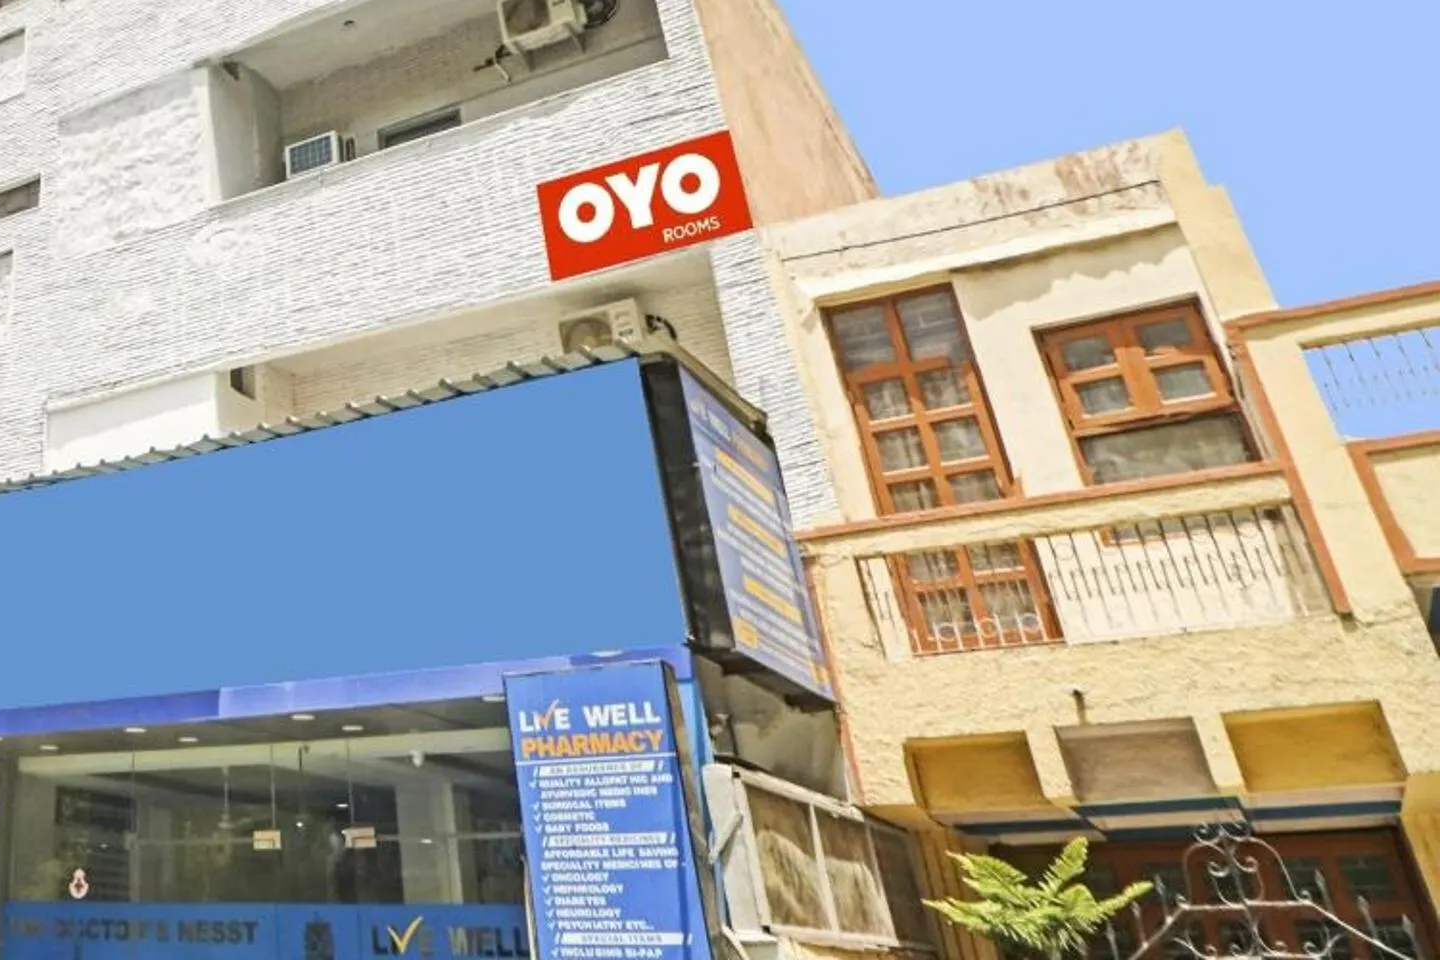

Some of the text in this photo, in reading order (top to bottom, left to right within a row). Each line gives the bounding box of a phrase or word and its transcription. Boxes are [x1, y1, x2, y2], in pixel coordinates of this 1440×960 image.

[558, 153, 720, 243] OYO
[662, 216, 721, 243] ROOMS
[582, 701, 661, 728] WELL
[521, 728, 663, 759] PHARMACY
[550, 872, 609, 882] ONCOLOGY
